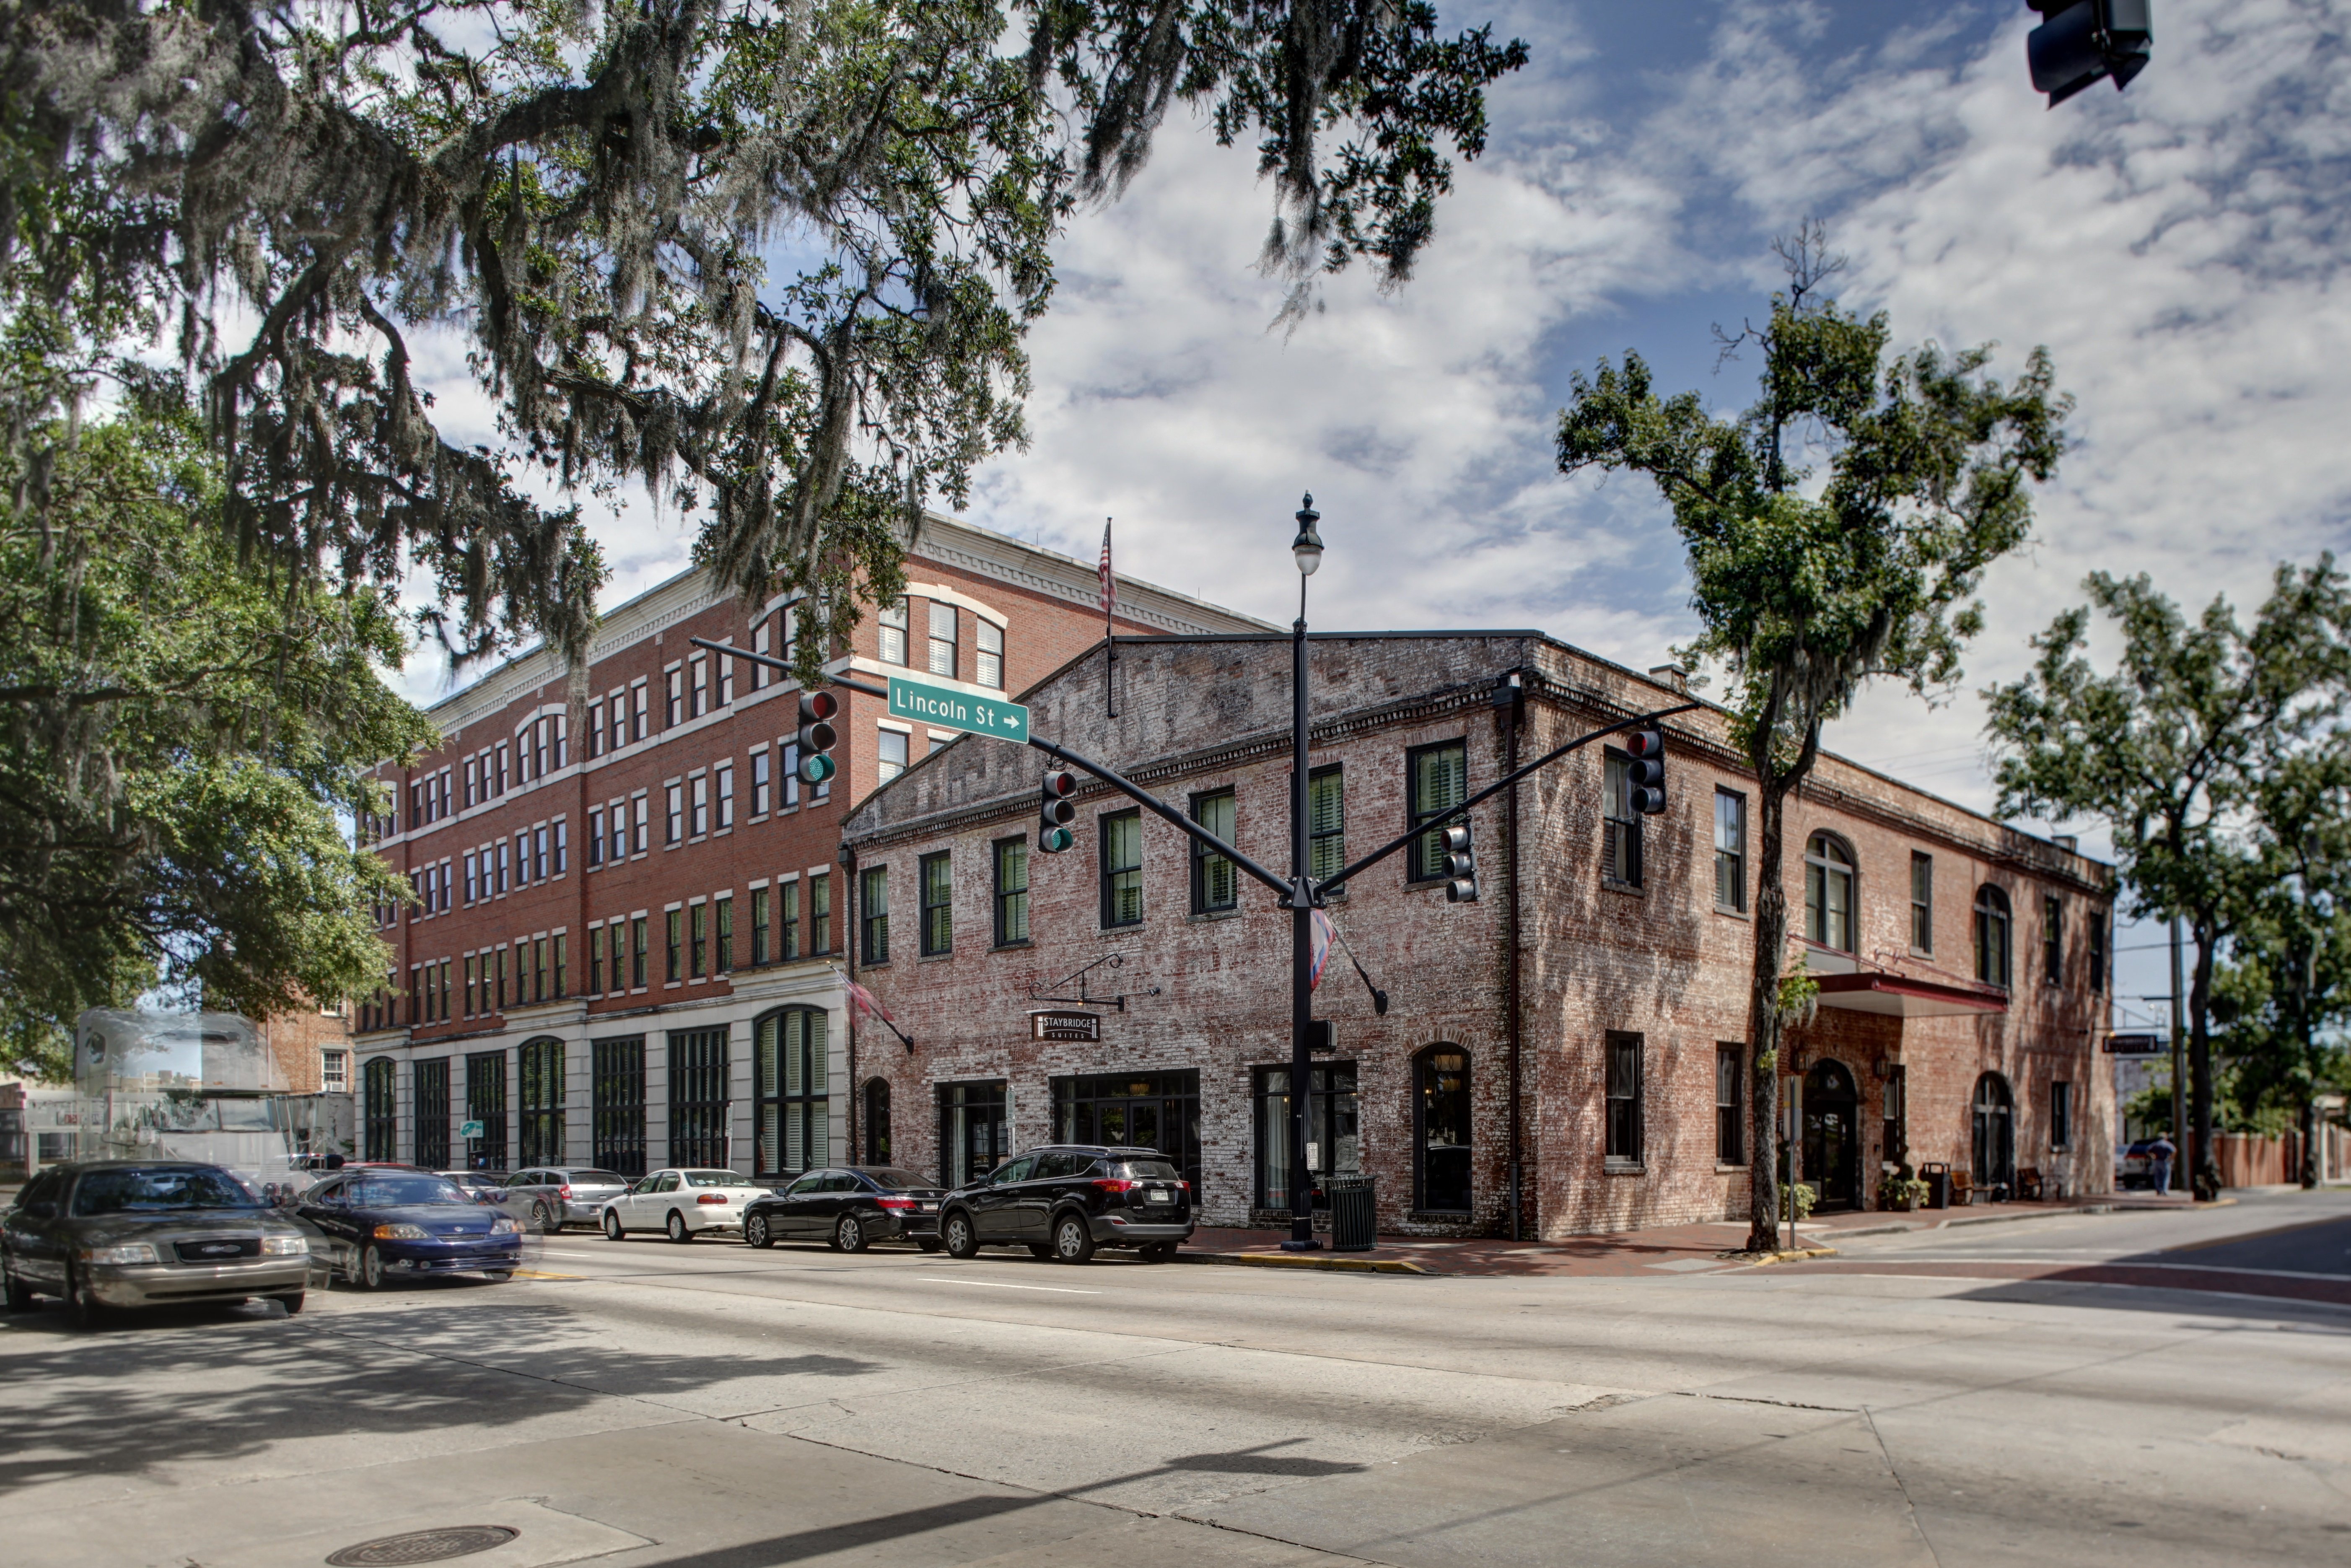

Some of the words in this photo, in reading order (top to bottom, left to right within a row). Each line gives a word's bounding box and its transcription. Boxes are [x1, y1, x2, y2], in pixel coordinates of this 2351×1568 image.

[897, 688, 966, 721] Lincoln
[976, 706, 994, 727] St
[1044, 1018, 1091, 1028] STAYBRIDGE
